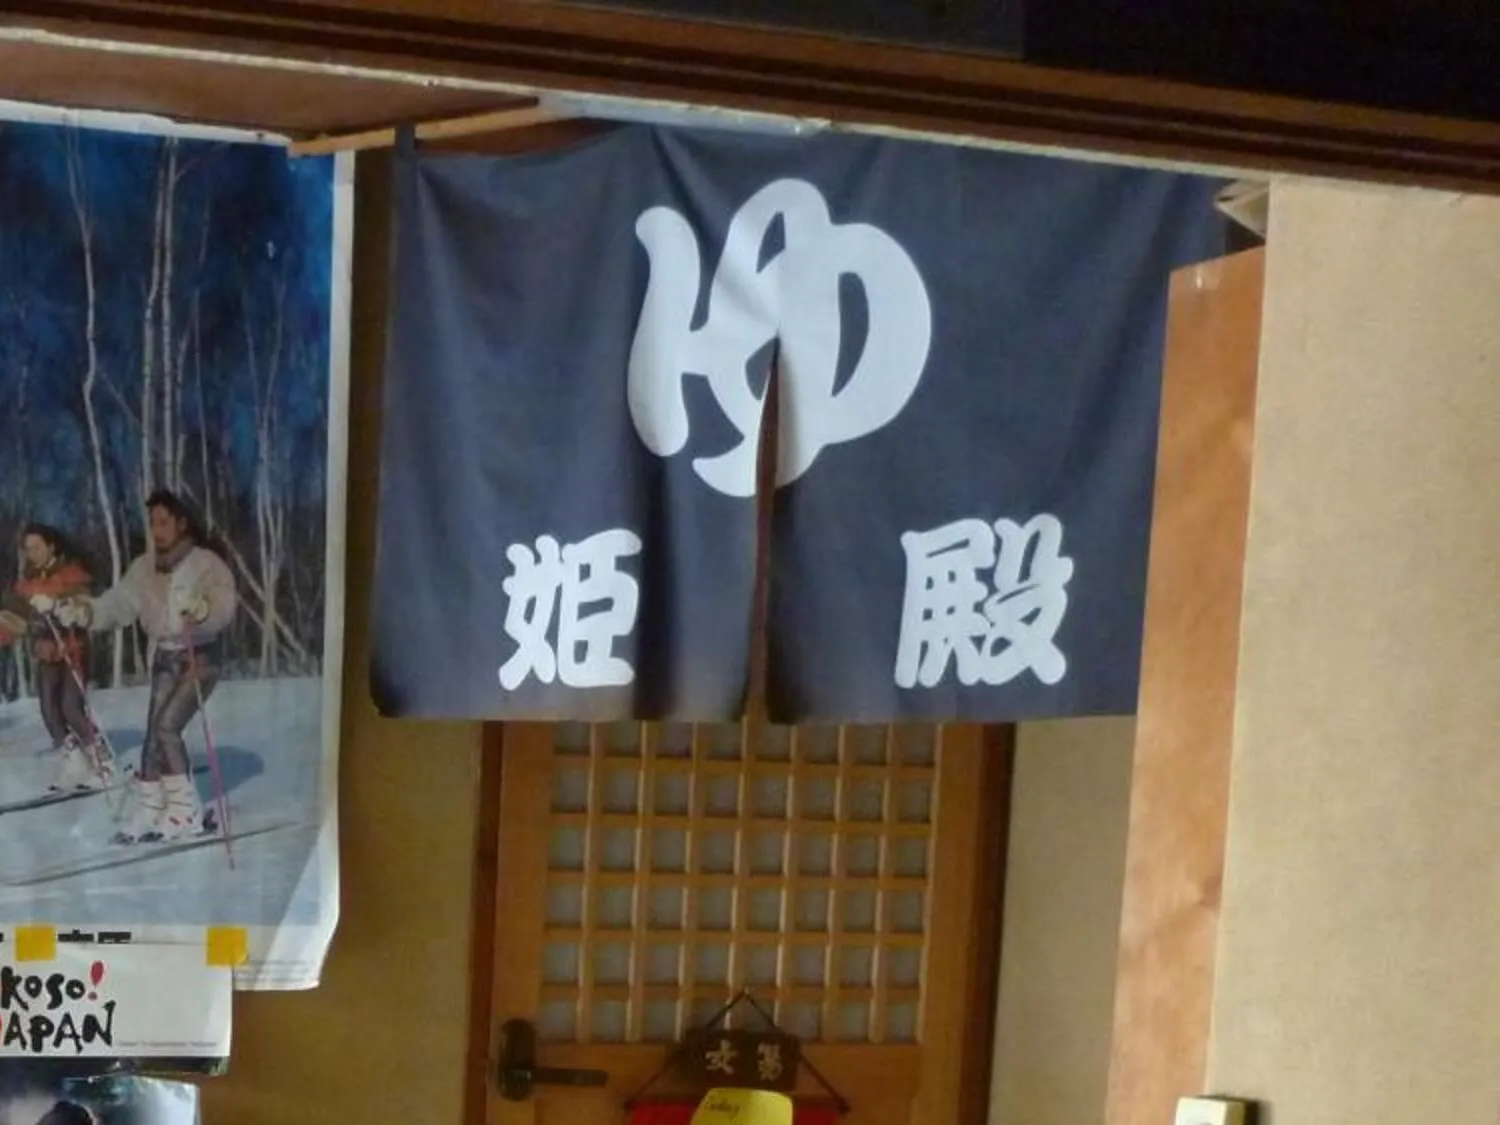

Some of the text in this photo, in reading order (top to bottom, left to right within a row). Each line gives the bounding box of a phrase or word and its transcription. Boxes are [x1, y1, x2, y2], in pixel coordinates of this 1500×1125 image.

[628, 178, 932, 498] ゆ
[498, 528, 642, 692] 姫
[895, 513, 1075, 690] 殿
